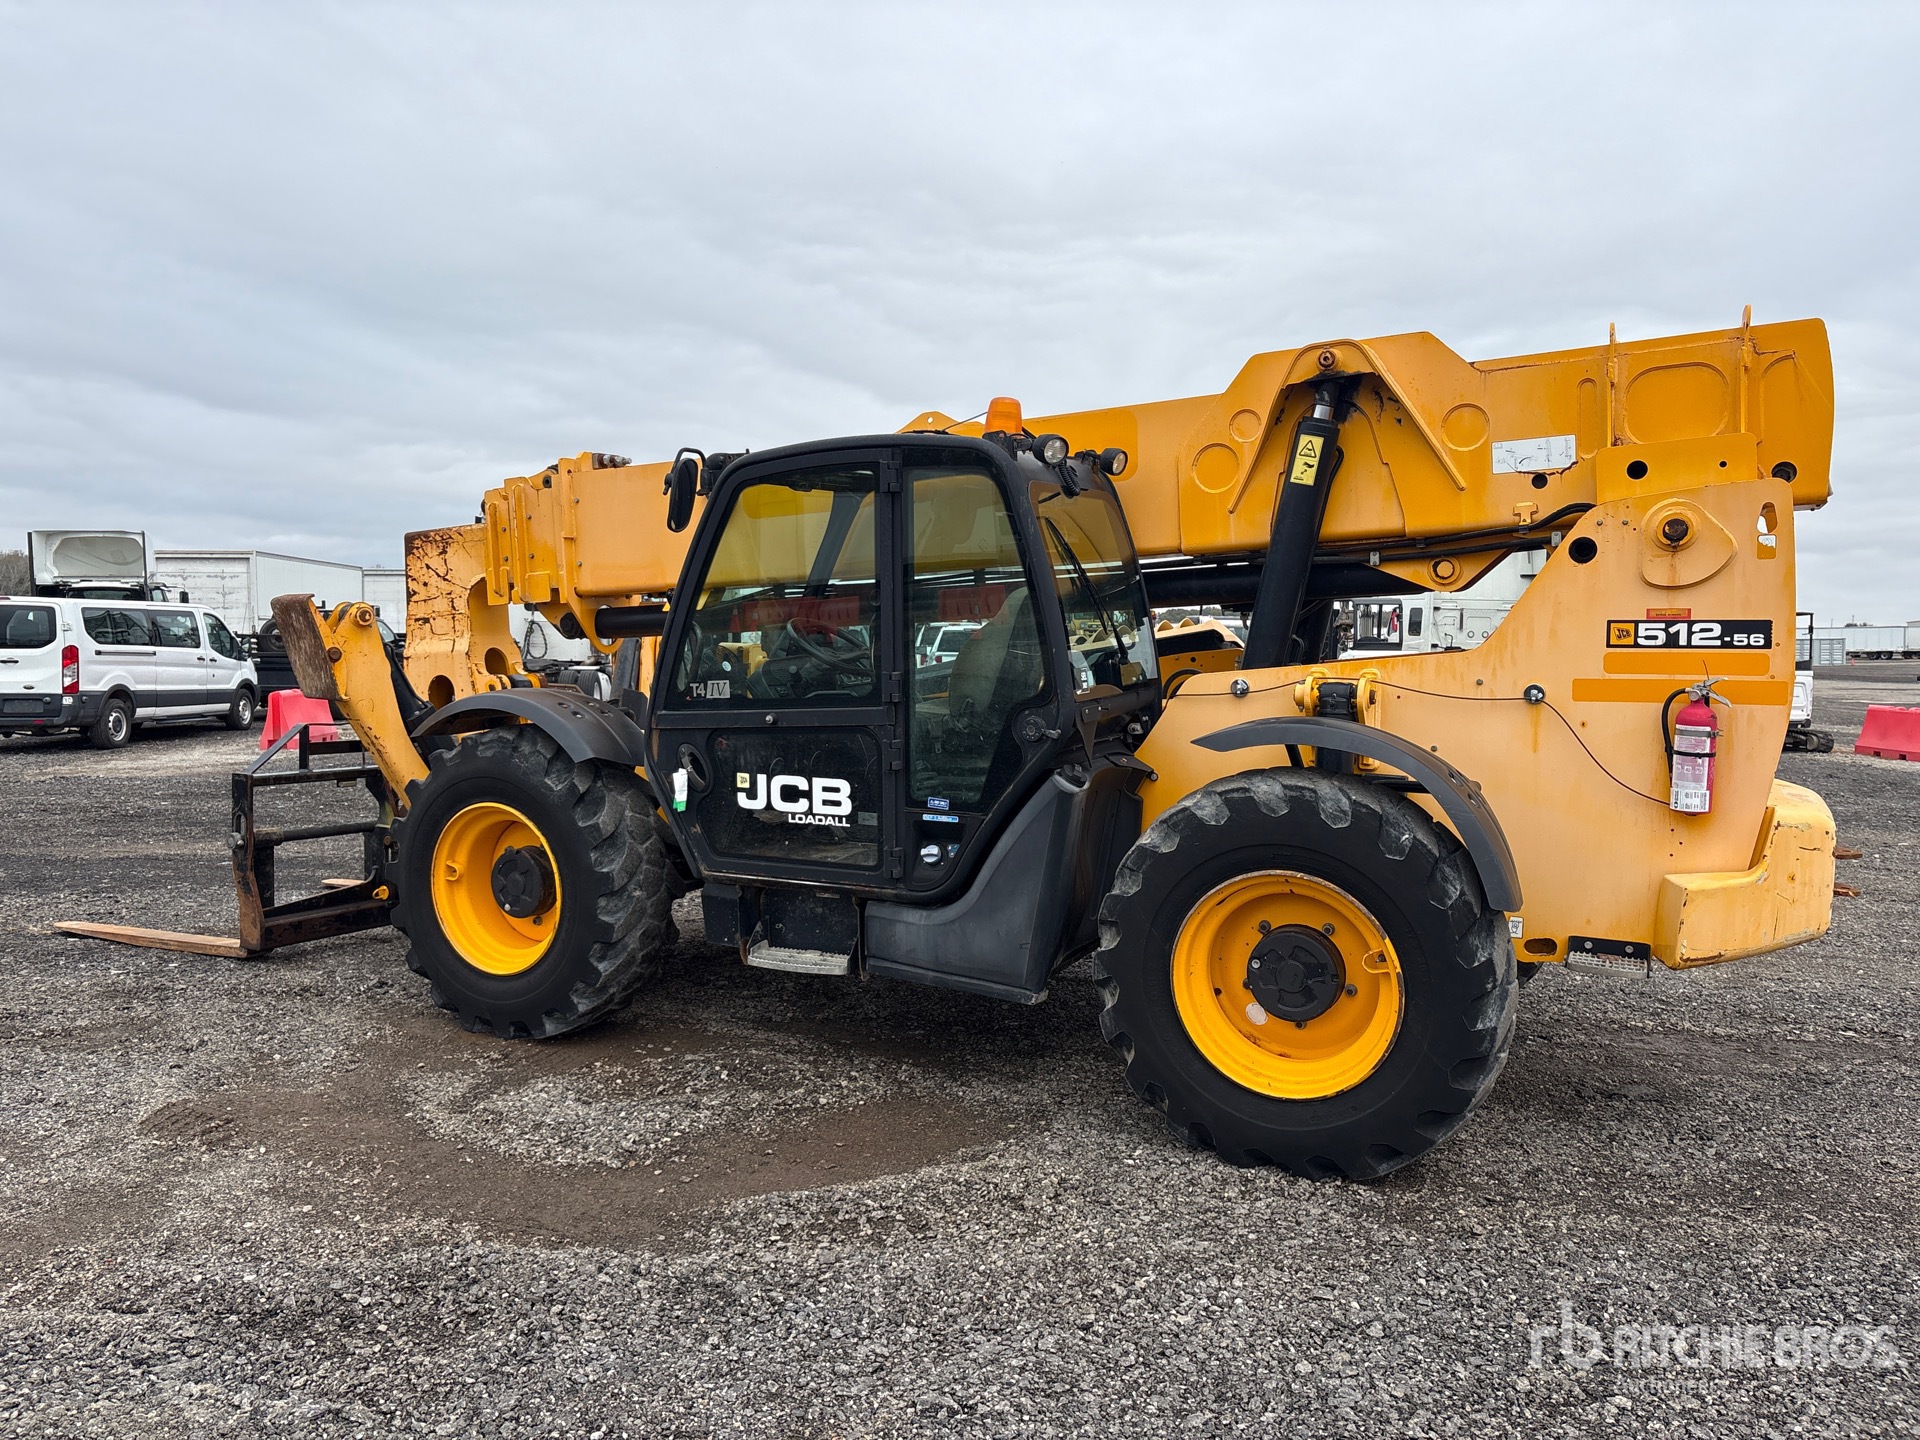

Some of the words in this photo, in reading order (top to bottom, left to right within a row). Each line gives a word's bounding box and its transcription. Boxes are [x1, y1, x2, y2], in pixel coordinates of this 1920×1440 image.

[1615, 627, 1632, 641] JCB
[690, 683, 706, 697] T4
[710, 682, 728, 697] IV
[737, 773, 852, 816] JCB
[788, 813, 850, 827] LOADALL
